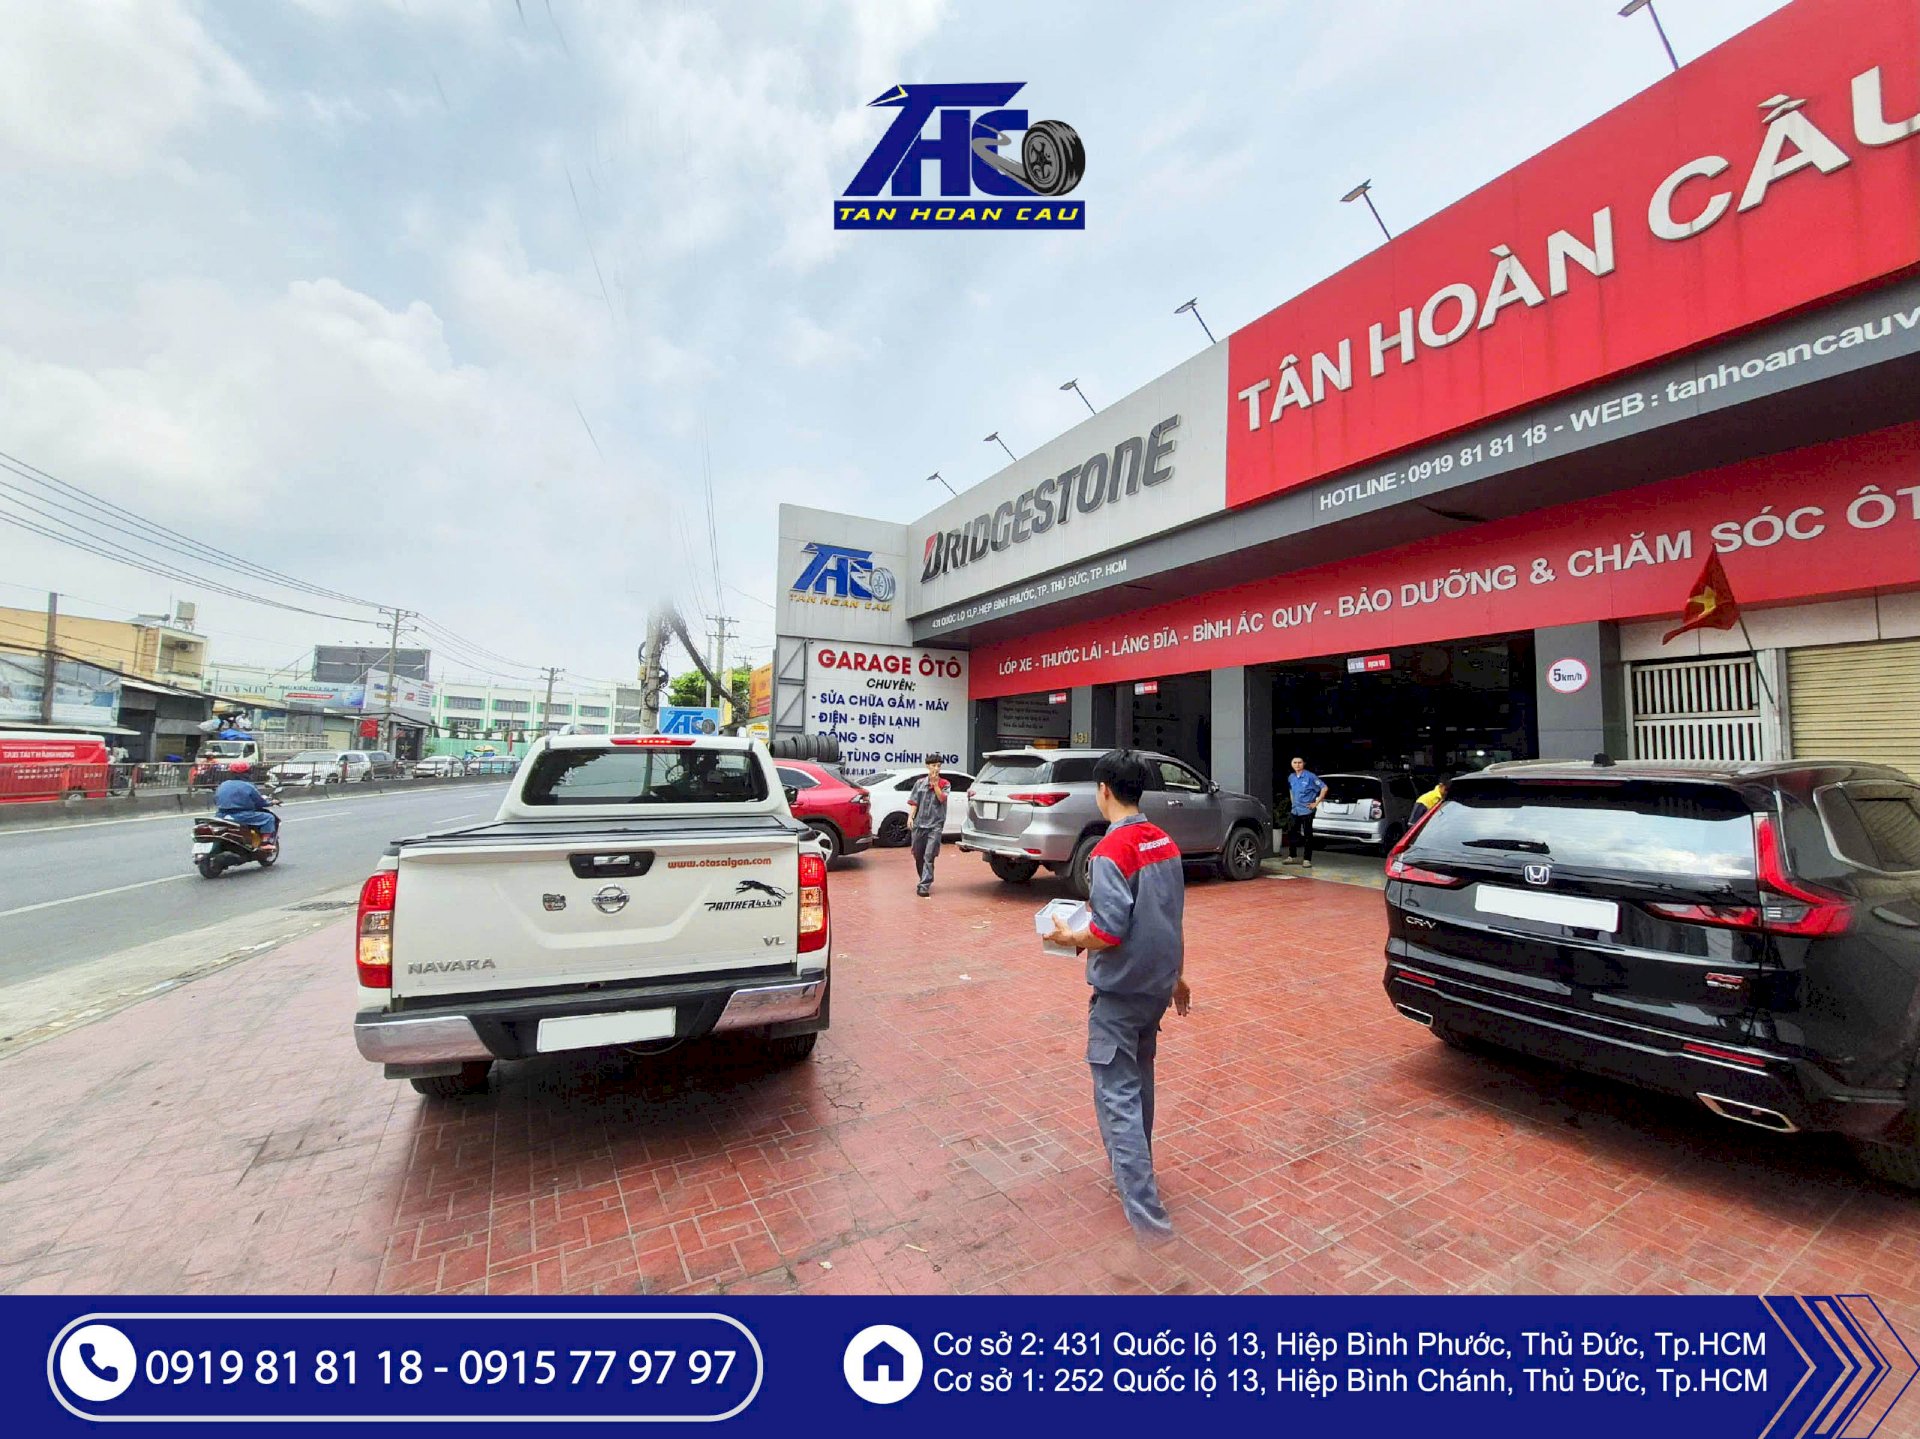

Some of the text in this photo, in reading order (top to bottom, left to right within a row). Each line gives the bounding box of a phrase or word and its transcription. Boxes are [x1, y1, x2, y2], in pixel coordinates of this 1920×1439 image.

[1238, 338, 1353, 433] TÂN
[1368, 206, 1616, 378] HOÀN
[1408, 454, 1453, 484] 0919
[1460, 444, 1483, 467] 81
[1489, 434, 1513, 458] 81
[1521, 424, 1547, 448] 18
[920, 414, 1181, 583] BRIDGESTONE
[1037, 586, 1049, 598] TP.
[1050, 577, 1066, 592] THỦ
[1090, 567, 1103, 580] TP.
[1105, 559, 1127, 576] HCM
[999, 655, 1017, 676] LỐP
[1019, 657, 1033, 672] XE
[1041, 646, 1080, 669] THƯỚC
[1082, 641, 1101, 661] LÁI
[1112, 635, 1150, 657] LÁNG
[1153, 626, 1179, 649] ĐĨA
[1193, 618, 1232, 642] BÌNH
[1236, 610, 1264, 635] ẮC
[1271, 602, 1317, 629] QUY
[1338, 587, 1393, 618] BẢO
[1400, 564, 1518, 608] DƯỠNG
[1529, 557, 1556, 585] &
[1567, 530, 1692, 579] CHĂM
[1711, 505, 1825, 554] SÓC
[818, 649, 961, 678] GARAGE ÔTÔ
[1553, 668, 1583, 682] 5km/h
[866, 678, 916, 692] CHUYÊN:
[820, 690, 845, 705] SỬA
[849, 694, 884, 708] CHỮA
[926, 698, 949, 711] MÁY
[819, 710, 848, 727] ĐIỆN
[859, 713, 886, 728] ĐIỆN
[889, 717, 920, 730] LẠNH
[869, 733, 894, 744] SƠN
[1072, 731, 1089, 744] 431
[847, 748, 880, 762] TÙNG
[884, 750, 922, 764] CHÍNH
[1405, 916, 1437, 929] CR-V
[763, 935, 785, 947] VL
[407, 957, 496, 975] NAVARA
